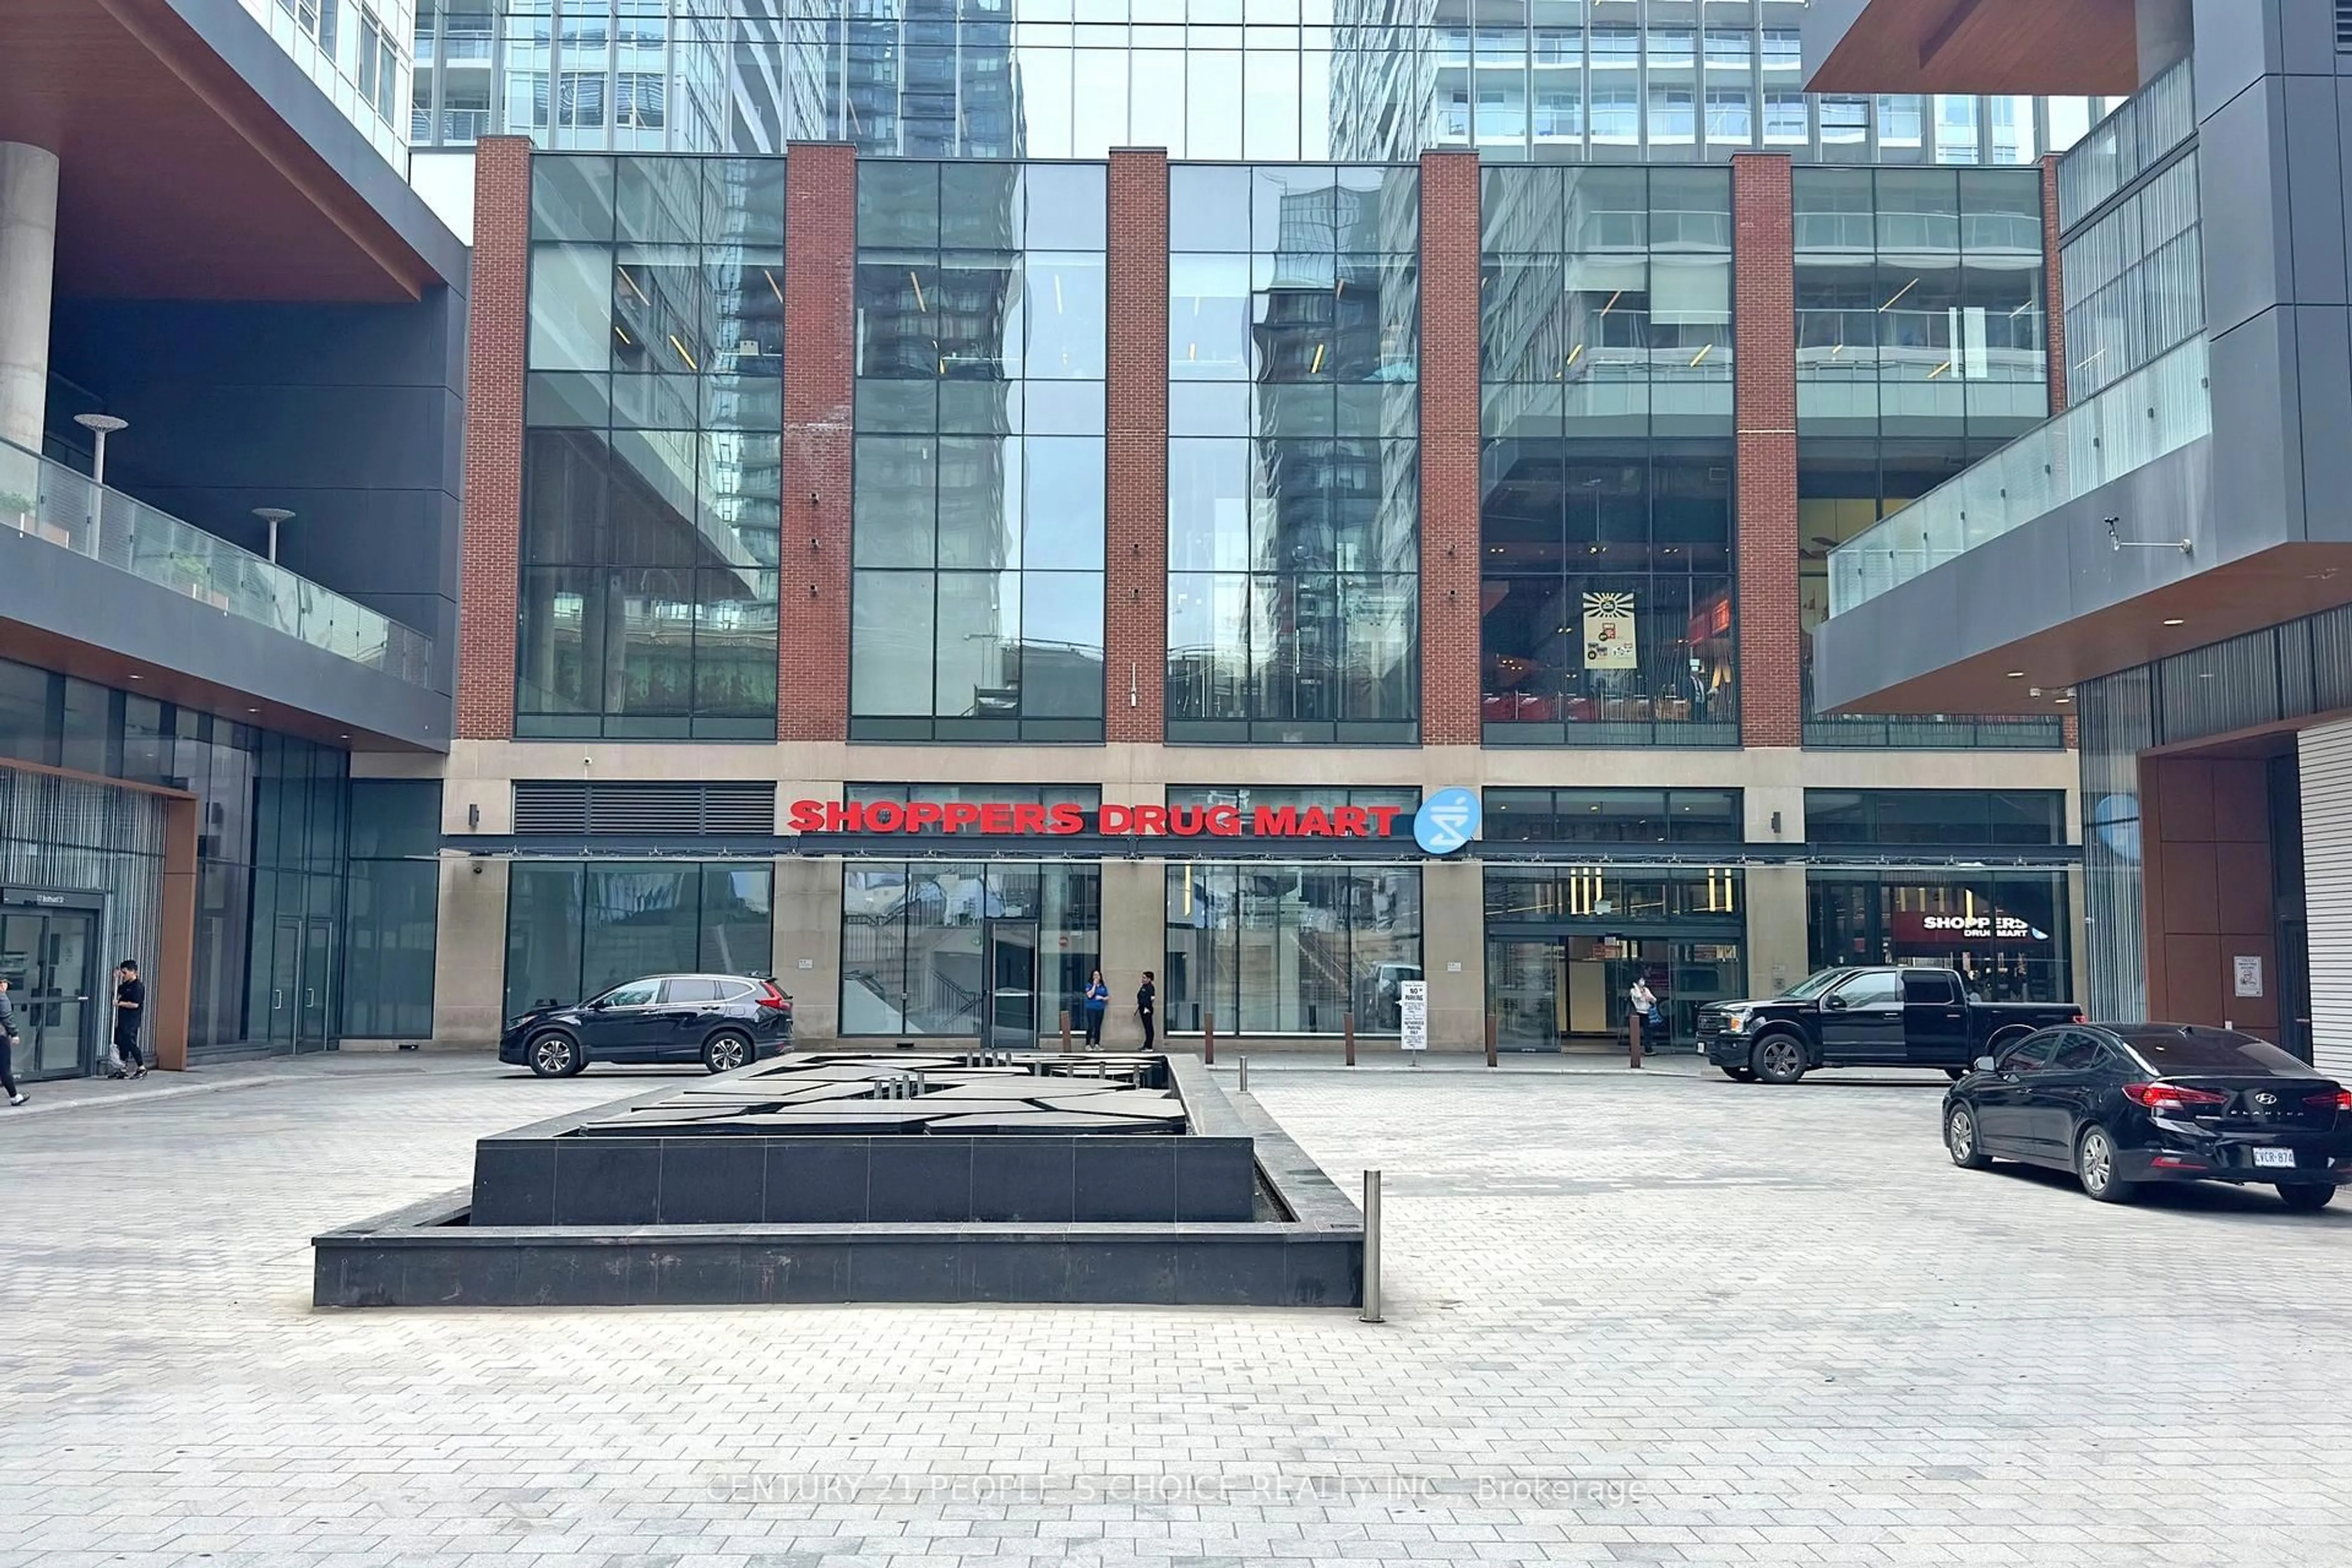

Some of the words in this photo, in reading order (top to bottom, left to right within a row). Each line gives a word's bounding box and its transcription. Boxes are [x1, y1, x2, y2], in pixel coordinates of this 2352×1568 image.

[790, 800, 1084, 834] SHOPPERS
[1099, 805, 1240, 835] DRUG
[1254, 806, 1400, 836] MART
